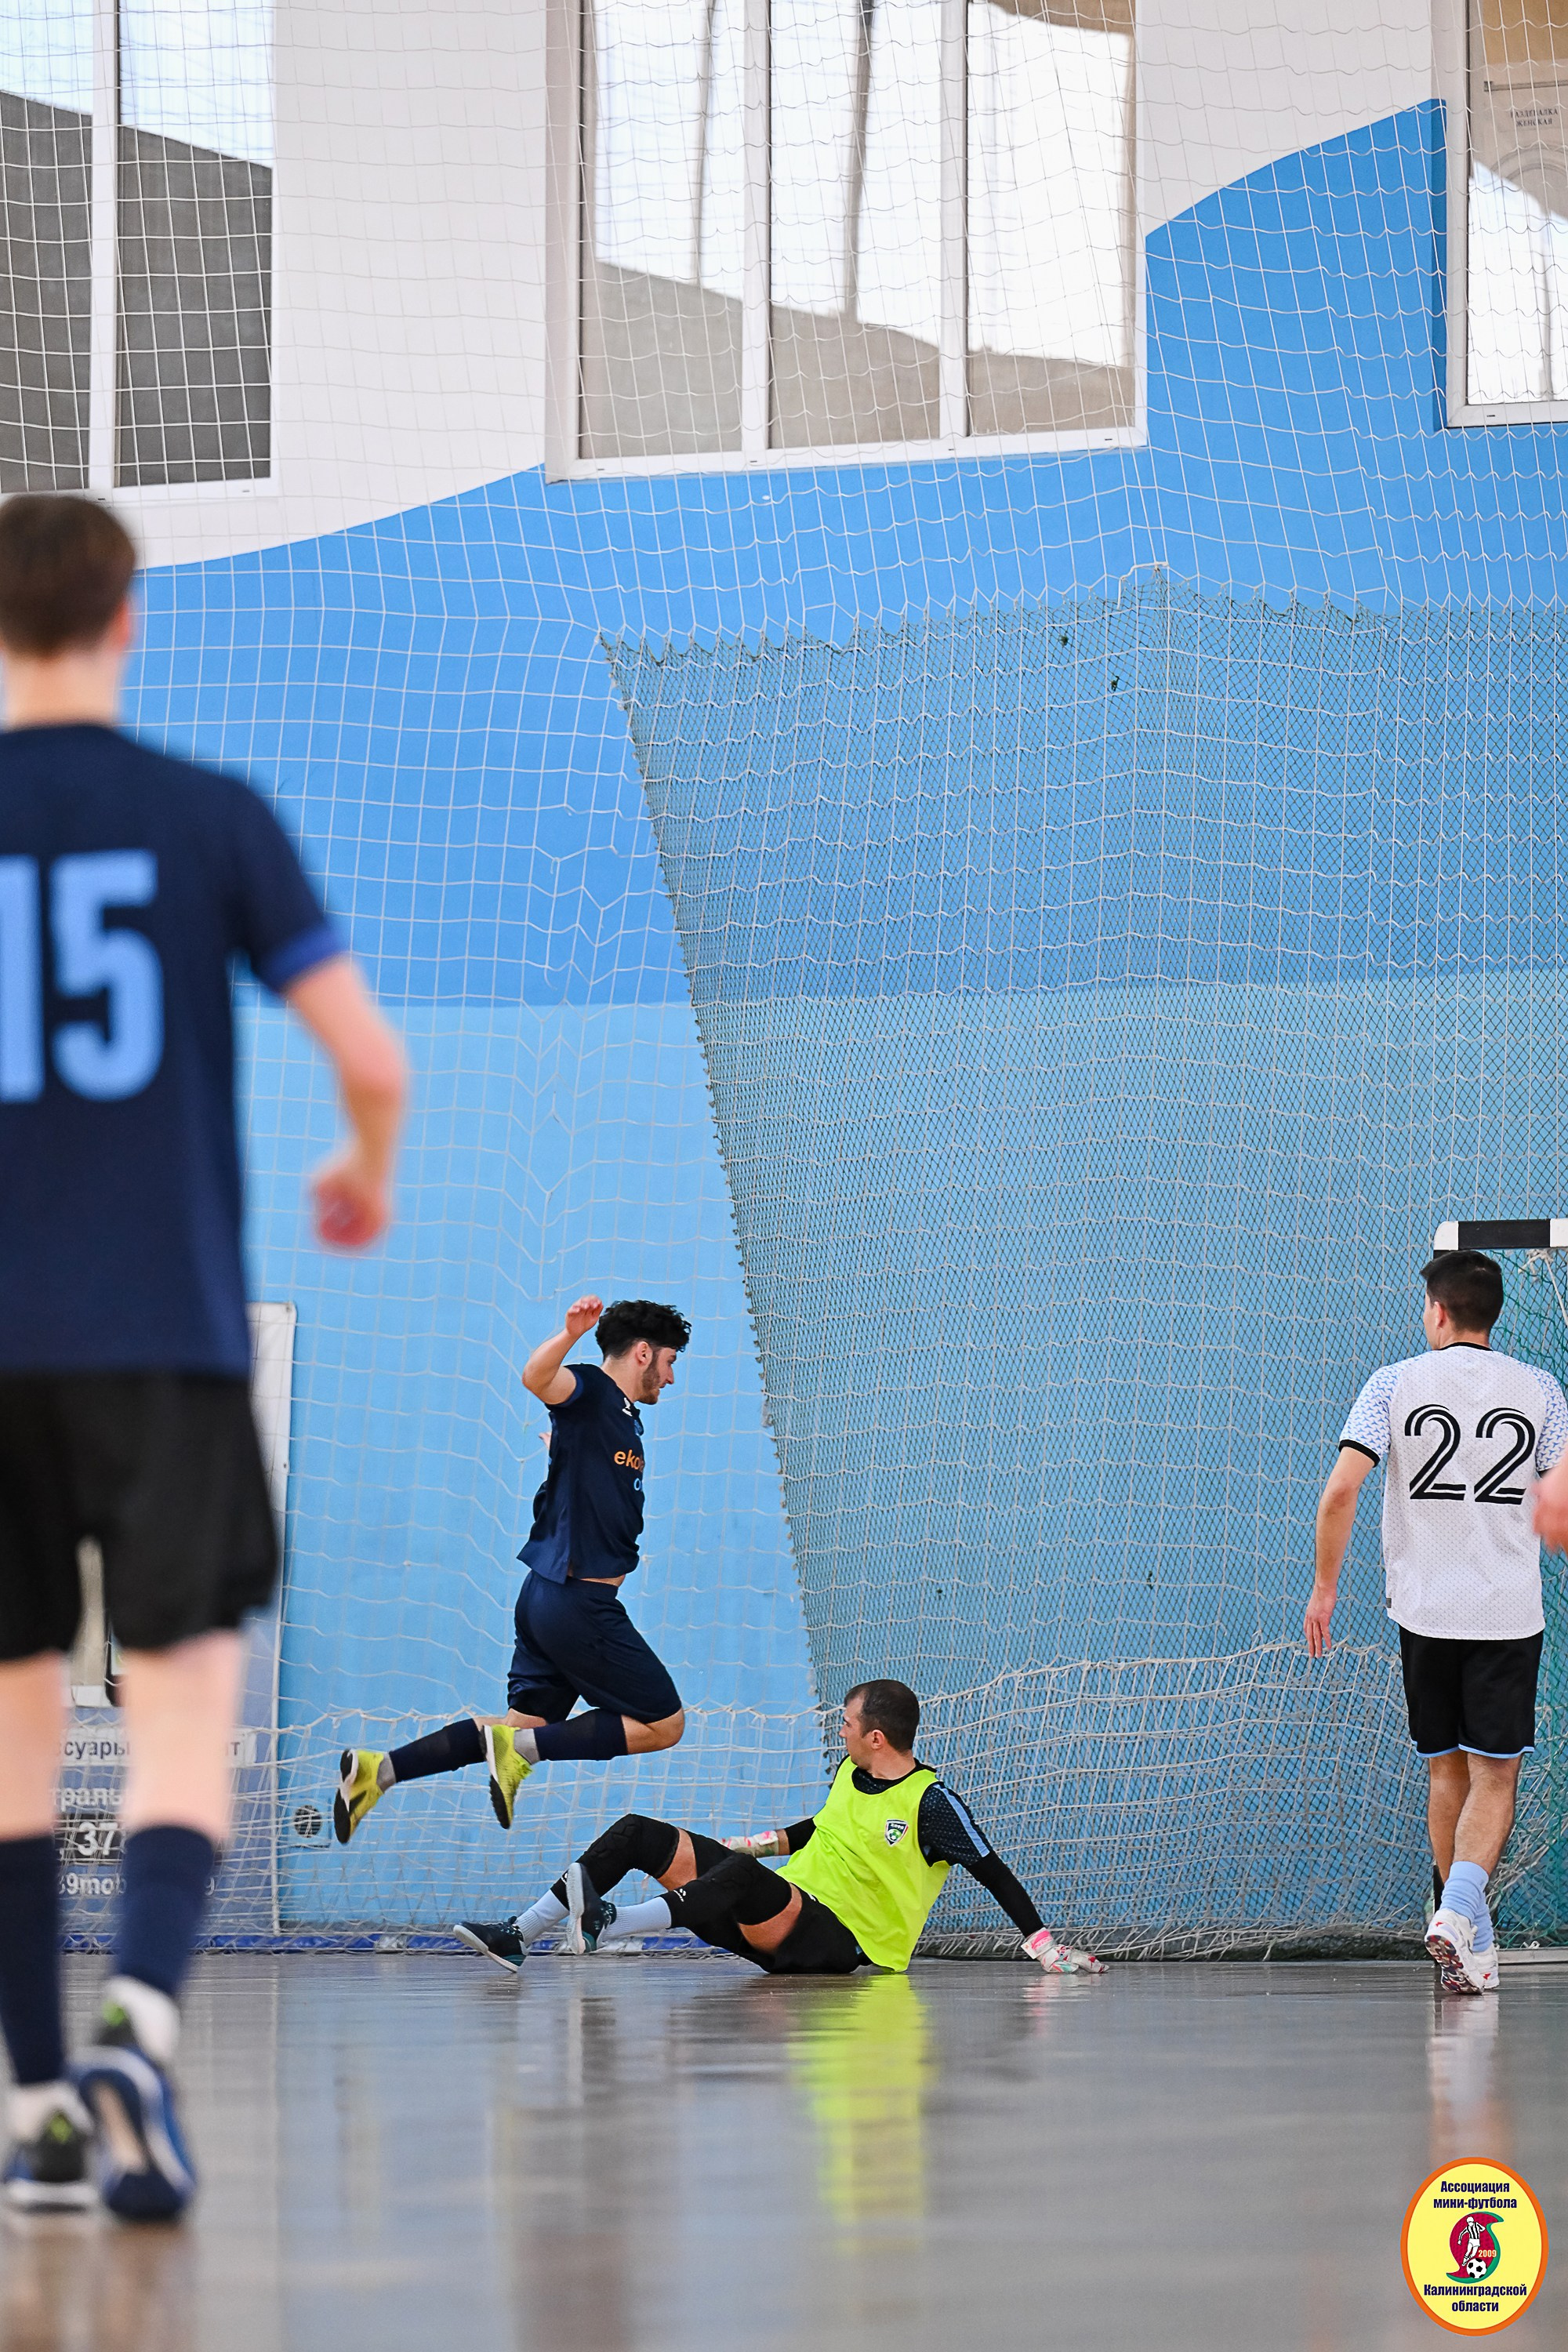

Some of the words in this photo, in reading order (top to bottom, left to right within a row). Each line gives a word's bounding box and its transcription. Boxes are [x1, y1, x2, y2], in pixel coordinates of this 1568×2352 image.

[0, 848, 165, 1102] 15
[1404, 1403, 1536, 1505] 22
[60, 1740, 130, 1760] суары
